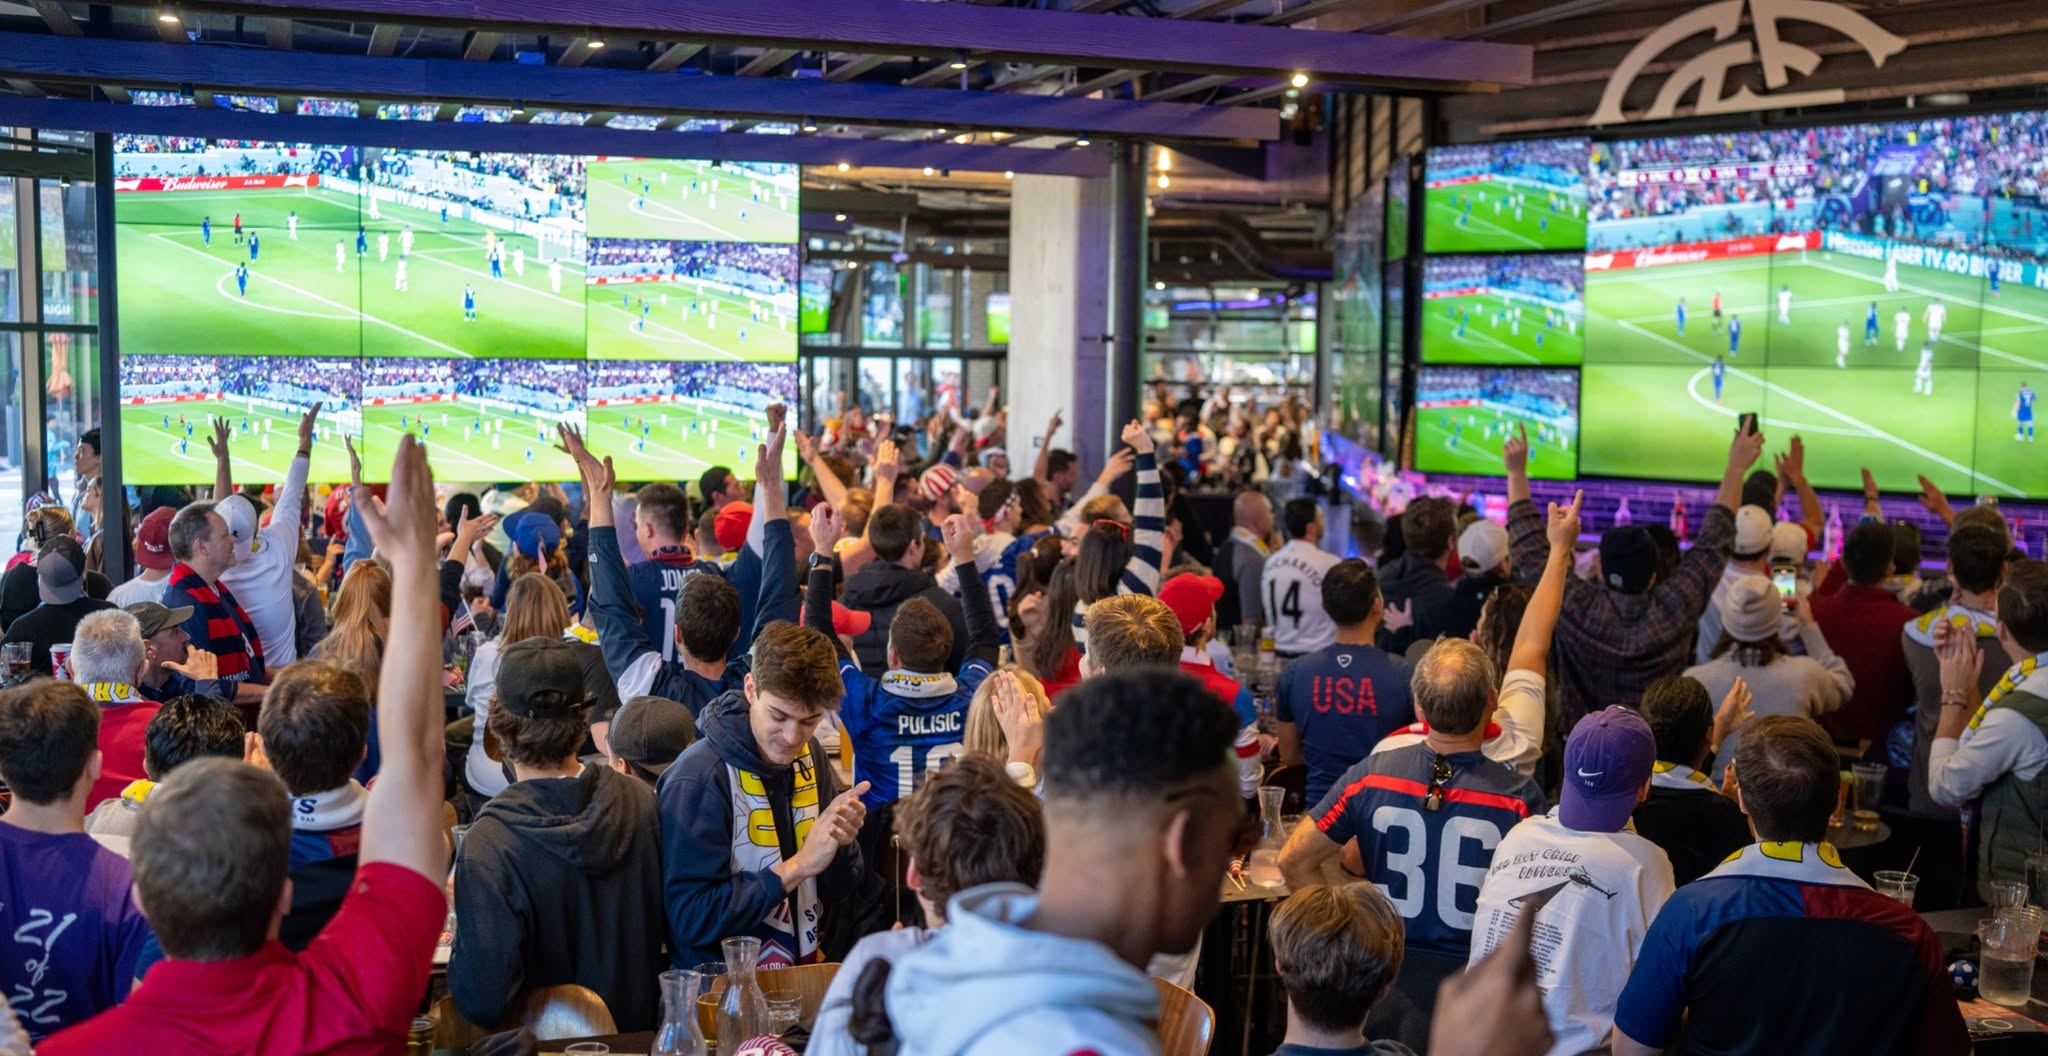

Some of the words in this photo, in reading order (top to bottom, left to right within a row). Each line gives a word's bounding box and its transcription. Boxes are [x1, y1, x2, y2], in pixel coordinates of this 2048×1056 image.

[160, 177, 229, 191] Budweiser
[660, 569, 703, 592] JON
[1269, 578, 1302, 629] 14
[1312, 675, 1378, 715] USA
[898, 711, 961, 735] PULISIC
[1371, 805, 1503, 930] 36
[14, 908, 77, 951] 21
[25, 952, 49, 987] of
